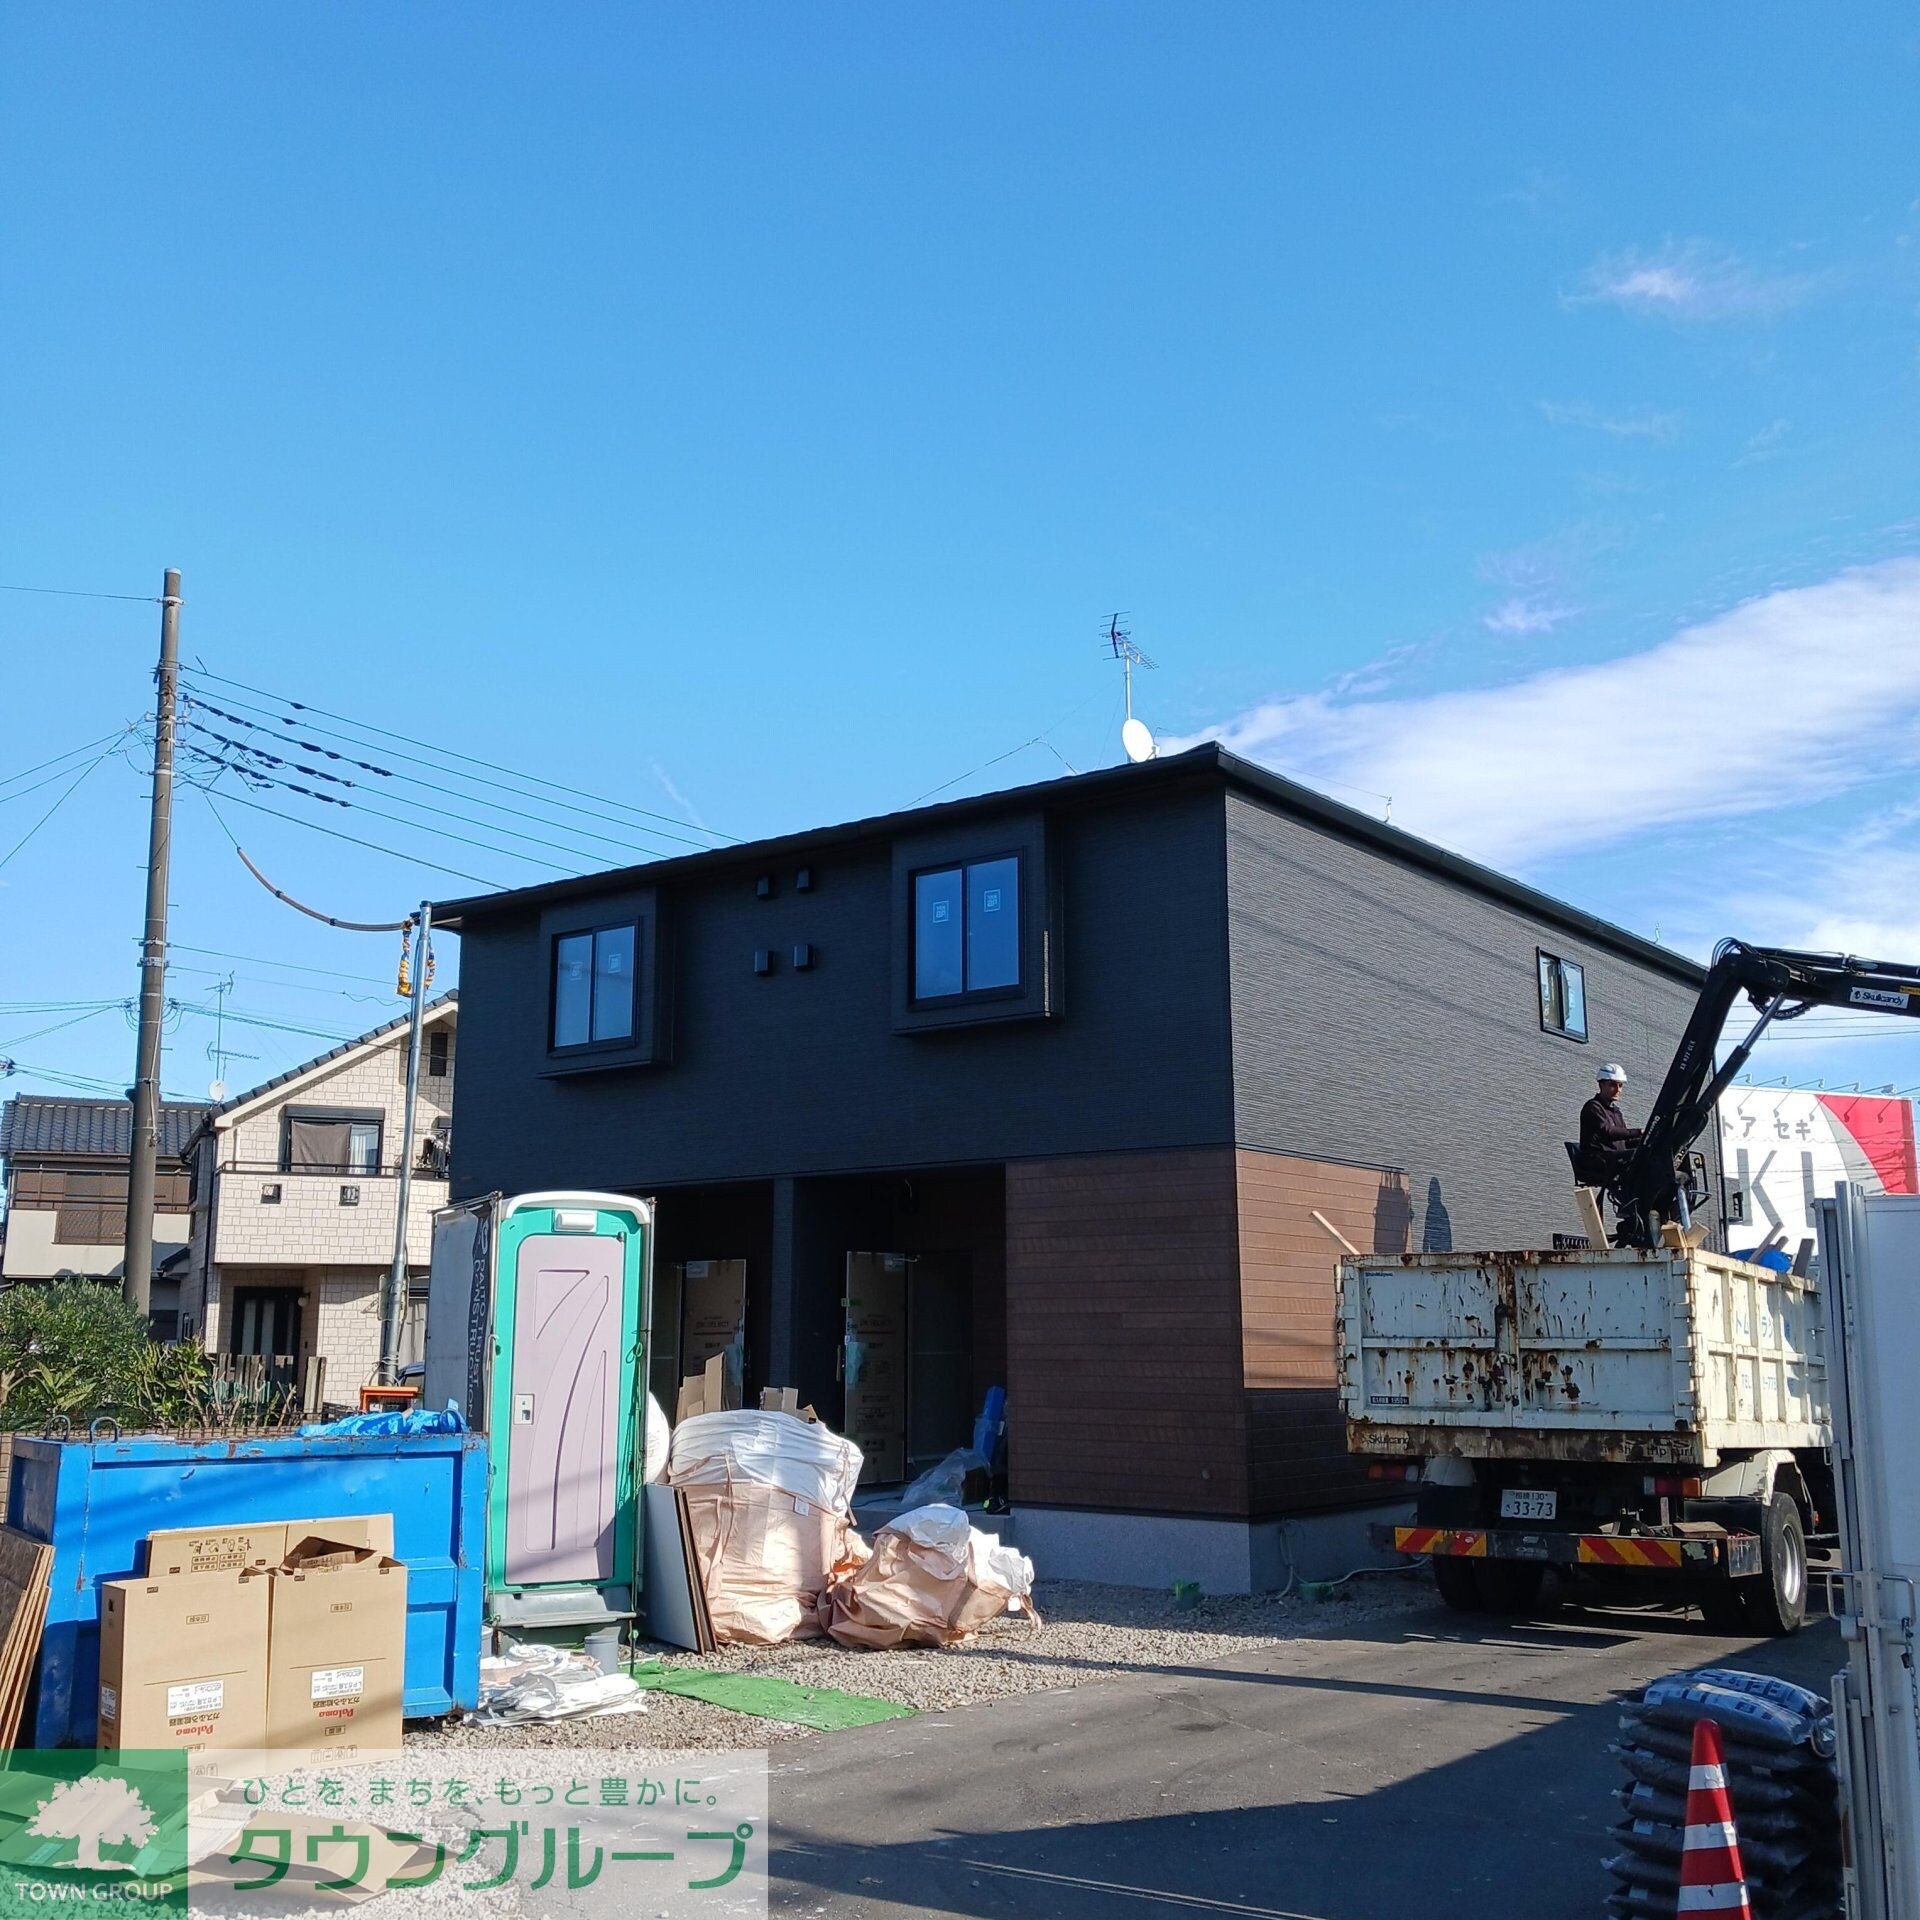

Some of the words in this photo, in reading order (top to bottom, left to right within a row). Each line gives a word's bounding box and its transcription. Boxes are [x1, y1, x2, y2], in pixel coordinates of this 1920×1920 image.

[473, 1323, 483, 1387] TRUST
[1513, 1501, 1553, 1516] 33-73
[318, 1708, 354, 1718] Paloma
[176, 1725, 213, 1736] Paloma
